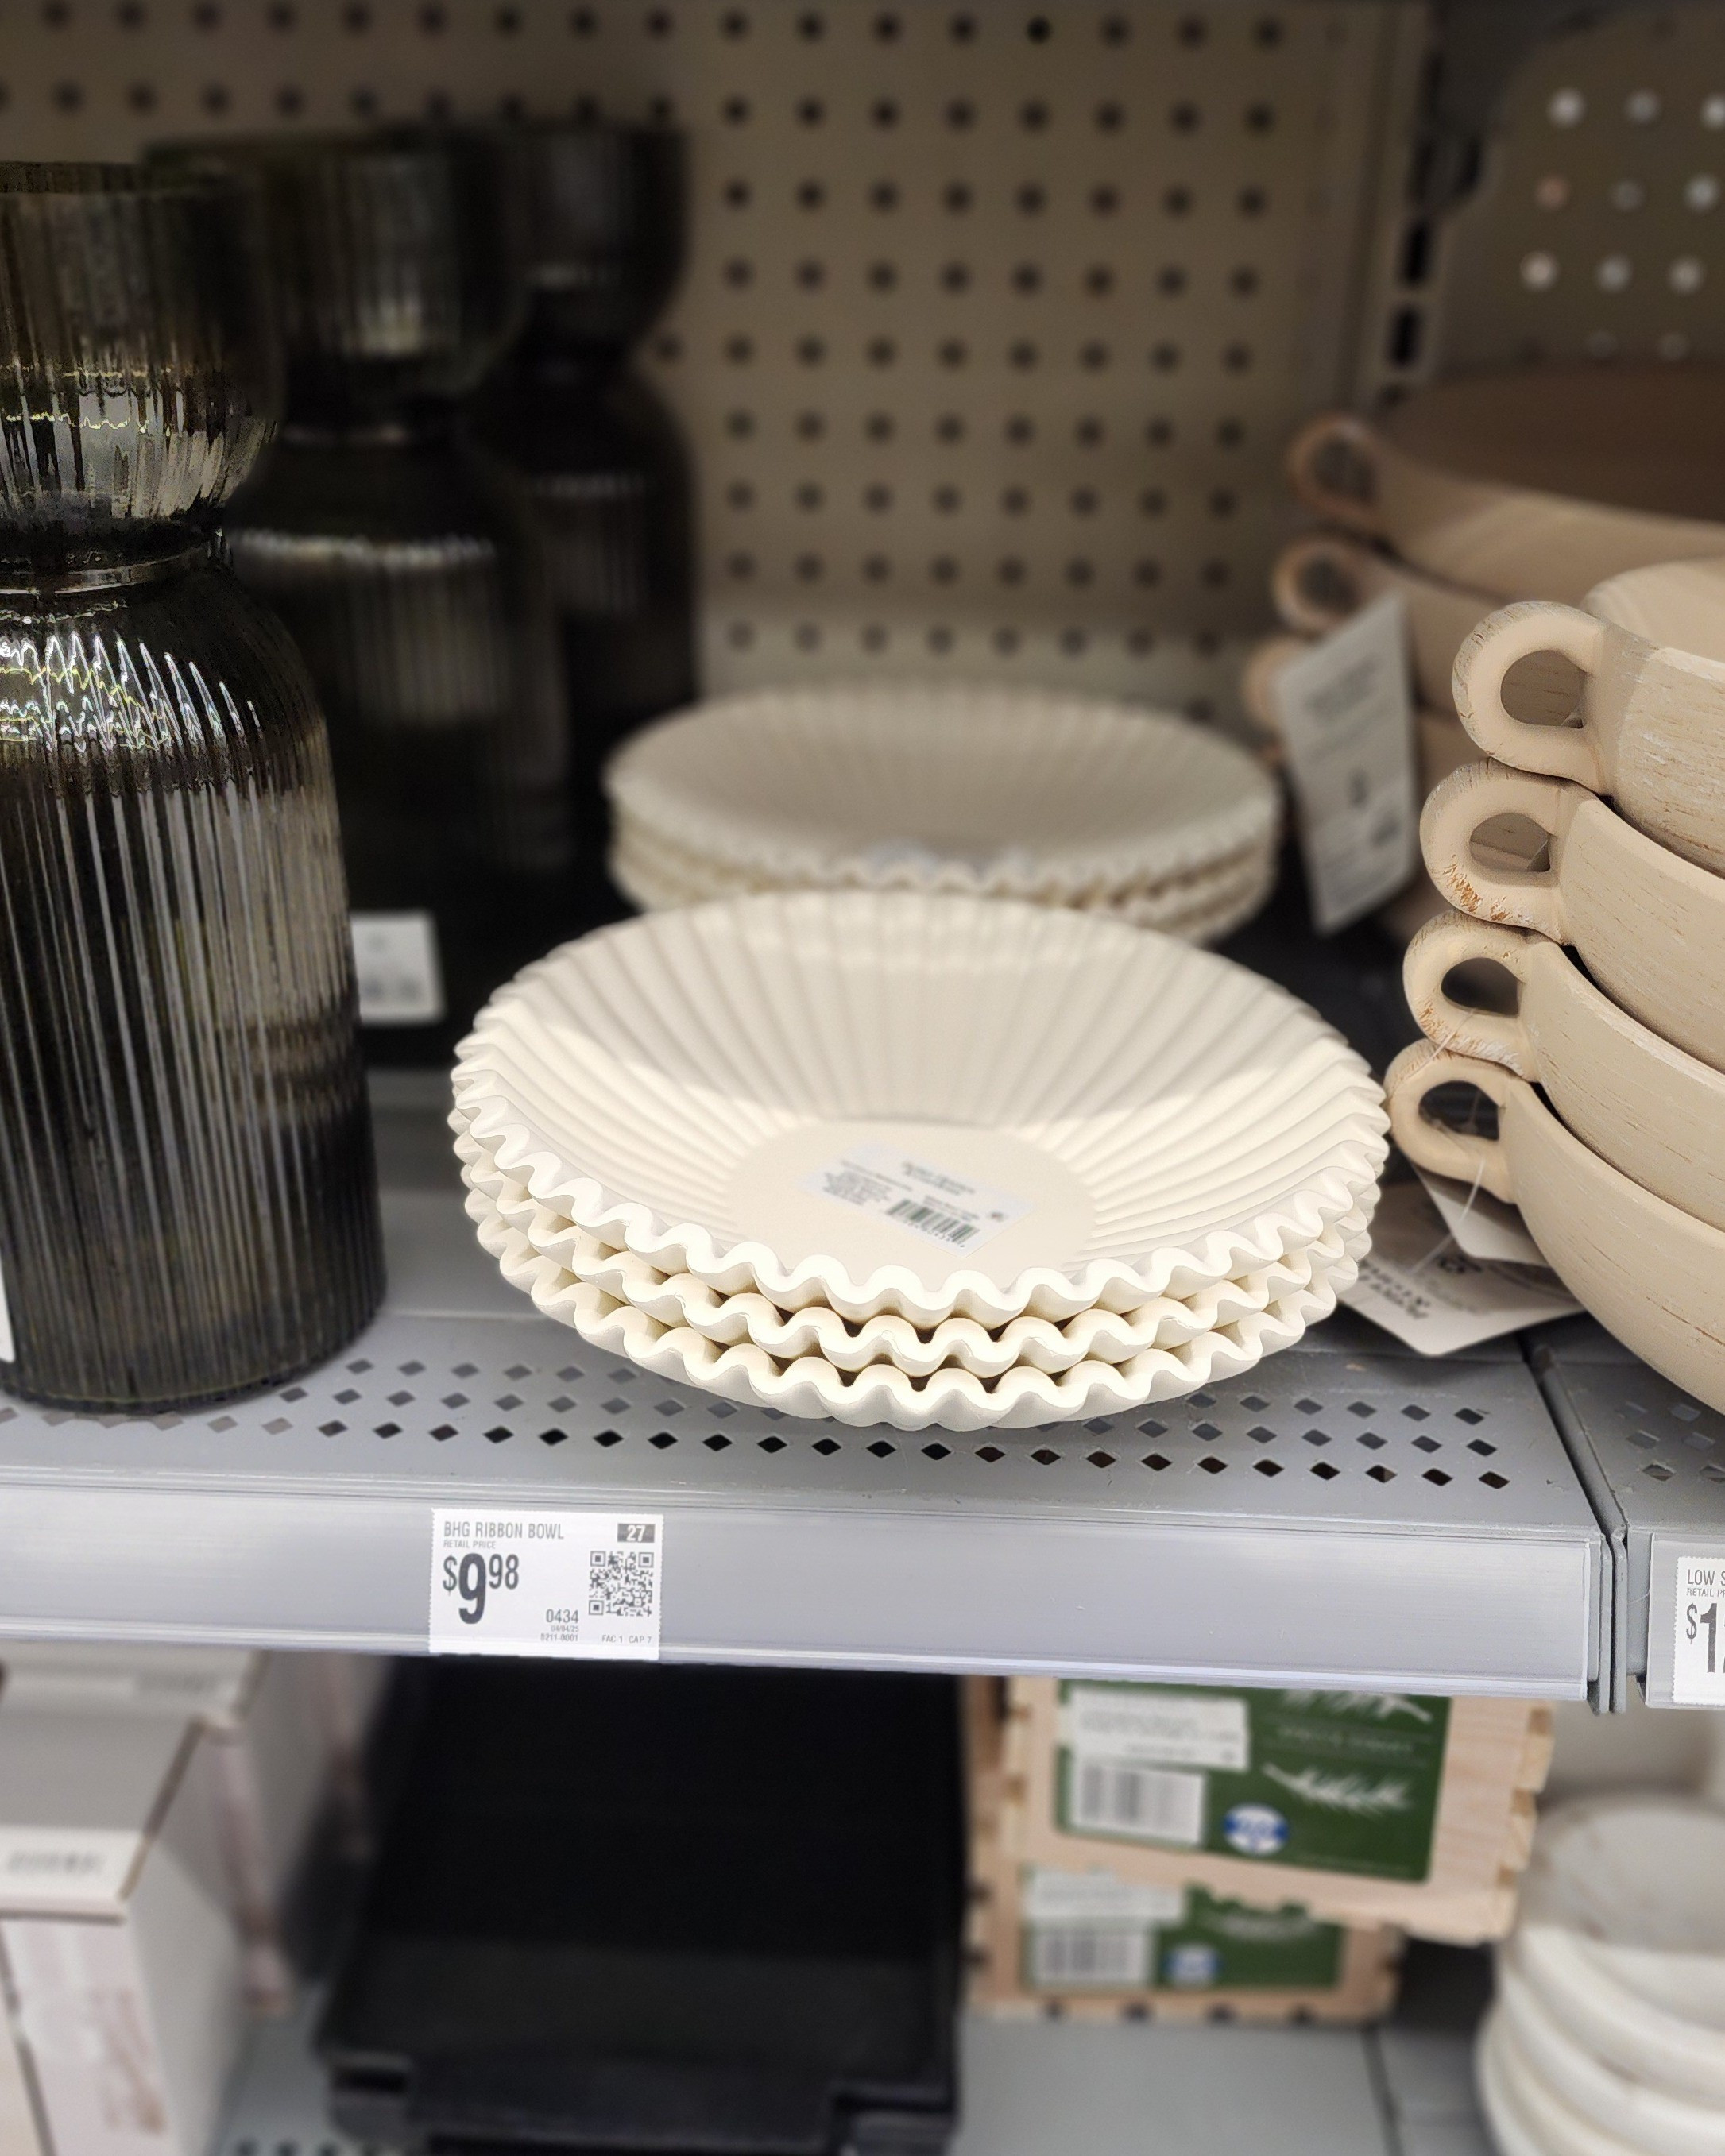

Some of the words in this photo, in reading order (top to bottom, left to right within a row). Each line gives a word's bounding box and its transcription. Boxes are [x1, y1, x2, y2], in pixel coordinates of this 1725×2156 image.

[443, 1521, 470, 1538] BHG
[475, 1522, 524, 1539] RIBBON
[528, 1523, 564, 1540] BOWL
[625, 1524, 645, 1542] 27
[443, 1540, 470, 1549] RETAIL
[473, 1540, 497, 1550] PRICE
[1687, 1569, 1715, 1586] LOW
[1686, 1588, 1714, 1597] RETAIL
[546, 1609, 579, 1624] 0434
[601, 1634, 617, 1643] FAC
